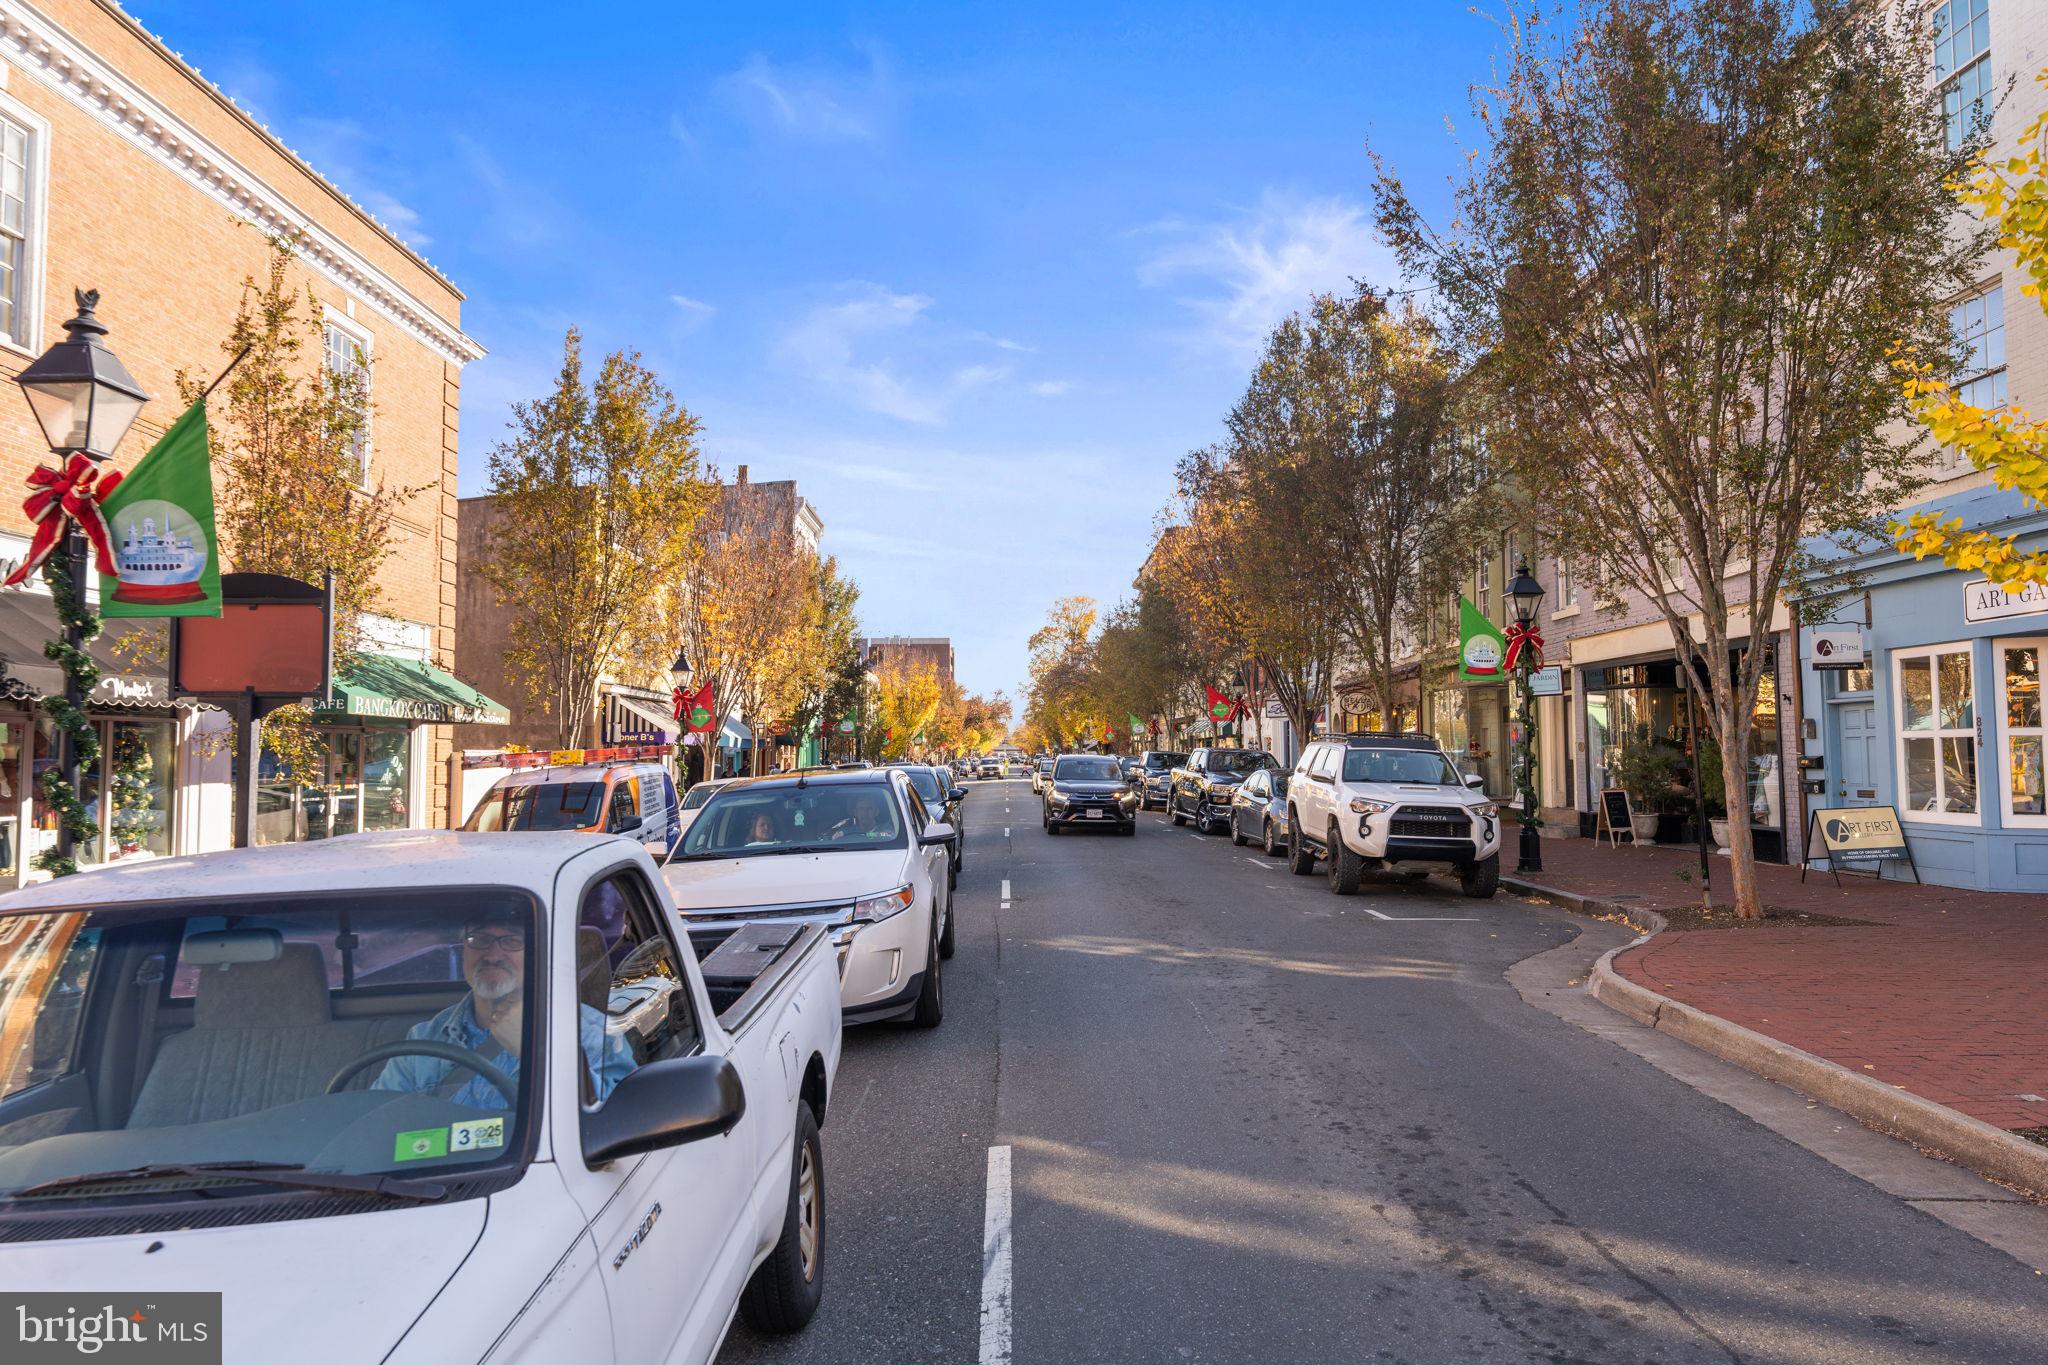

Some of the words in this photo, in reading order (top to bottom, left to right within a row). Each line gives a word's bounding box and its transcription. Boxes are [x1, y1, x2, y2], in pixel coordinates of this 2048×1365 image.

[1976, 589, 2010, 610] ART
[1840, 643, 1859, 651] First
[313, 699, 345, 710] CAFE
[355, 696, 412, 719] BANGKOK
[414, 702, 440, 720] CAFE
[474, 708, 506, 724] Cuisine
[619, 733, 638, 741] oner
[640, 733, 655, 741] B's
[1865, 821, 1893, 832] FIRST
[459, 1129, 470, 1145] 3
[487, 1125, 502, 1137] 25
